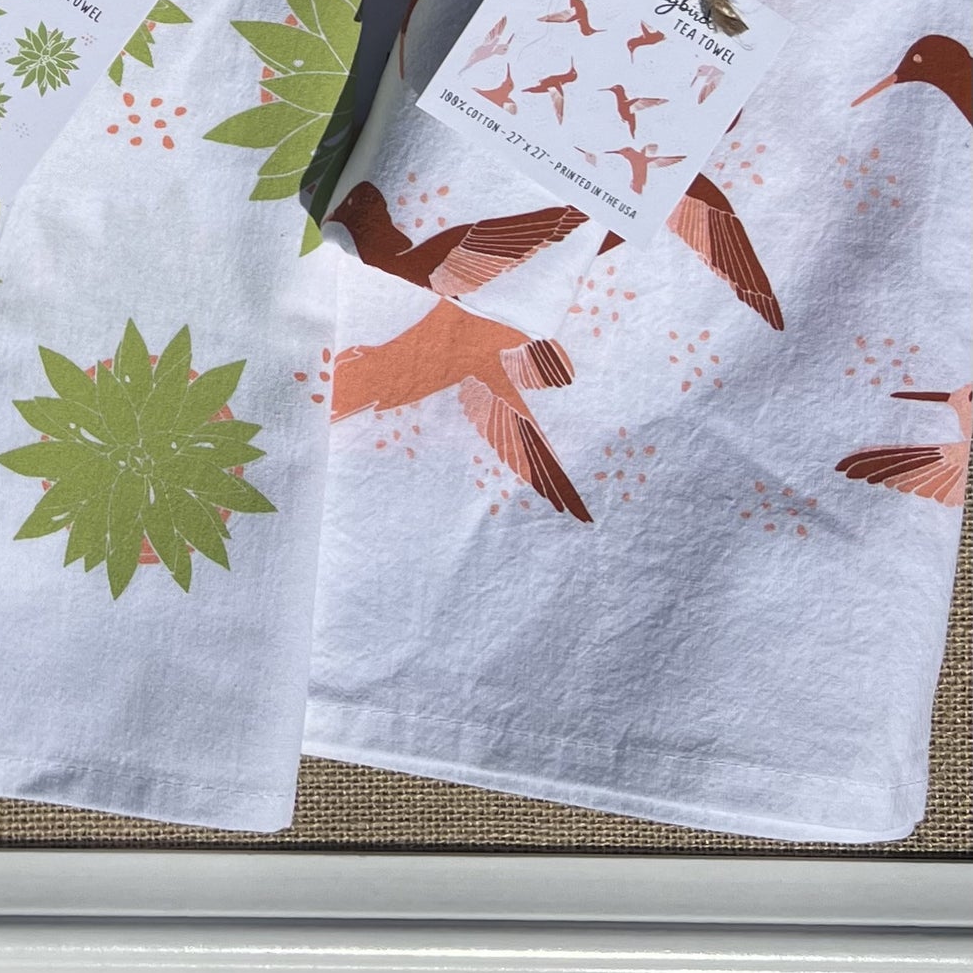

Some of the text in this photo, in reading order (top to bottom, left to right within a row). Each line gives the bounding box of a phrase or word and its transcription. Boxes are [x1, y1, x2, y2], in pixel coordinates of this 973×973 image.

[673, 18, 736, 65] TEA TOWEL
[439, 88, 467, 111] 100%
[465, 106, 501, 133] COTTON
[553, 161, 592, 190] PRINTED
[590, 184, 602, 197] IN
[601, 191, 619, 208] THE
[618, 202, 637, 219] USA
